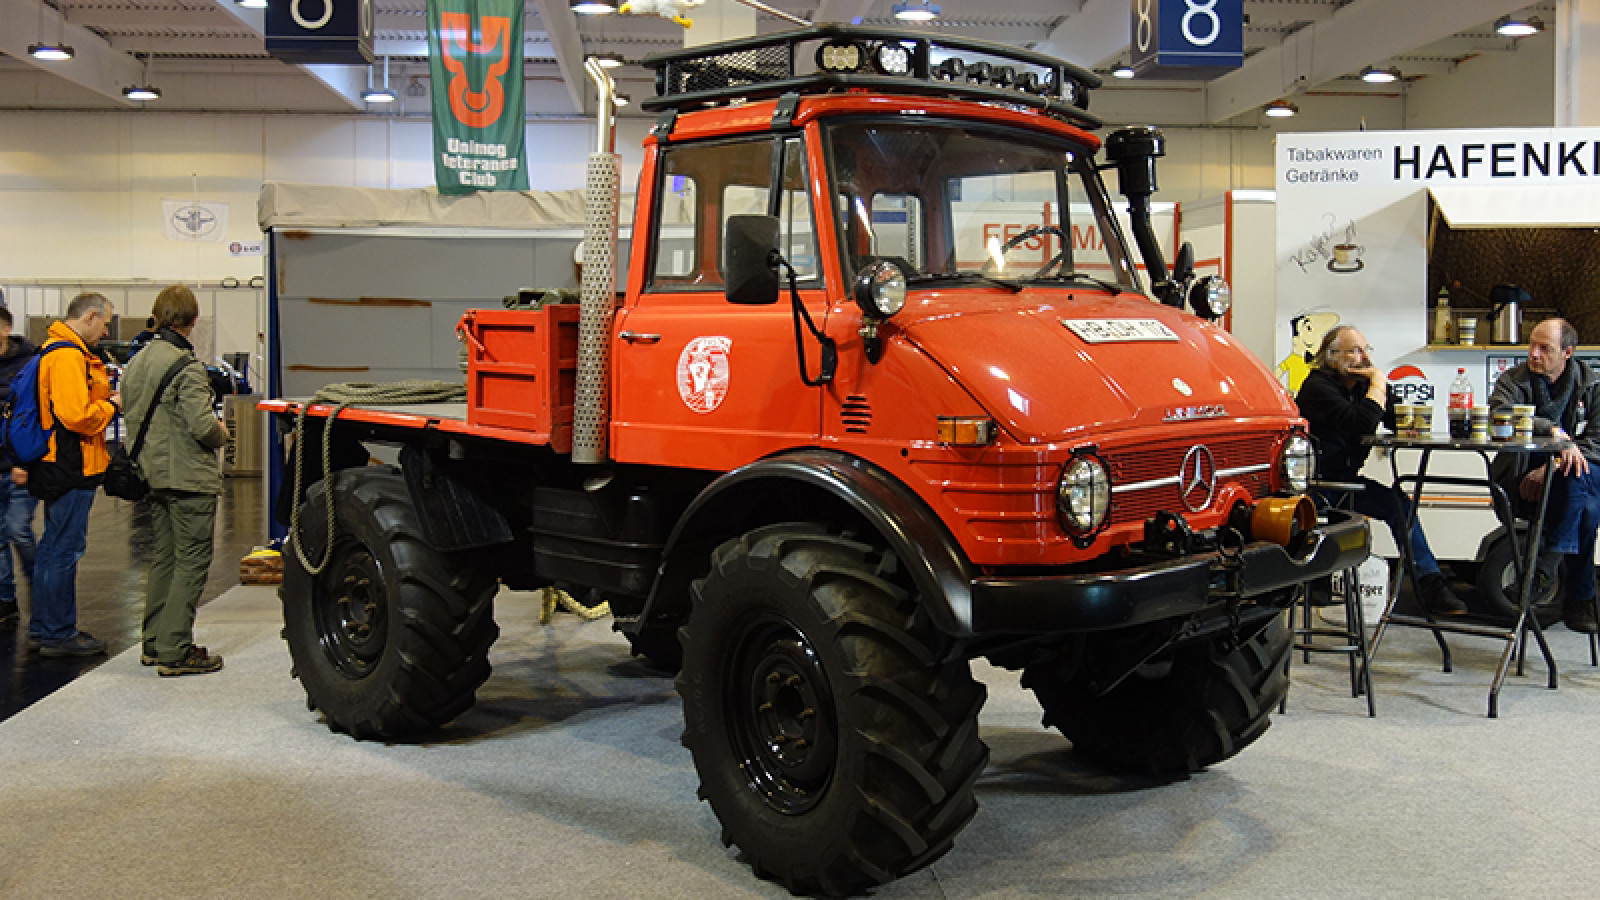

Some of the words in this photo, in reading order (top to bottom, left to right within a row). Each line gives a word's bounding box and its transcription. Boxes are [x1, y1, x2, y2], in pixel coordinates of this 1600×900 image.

[447, 138, 506, 158] Unimog
[1286, 147, 1383, 162] Tabakwaren
[459, 170, 496, 186] Club
[1285, 168, 1359, 183] Getränke
[1387, 383, 1435, 401] EPSI
